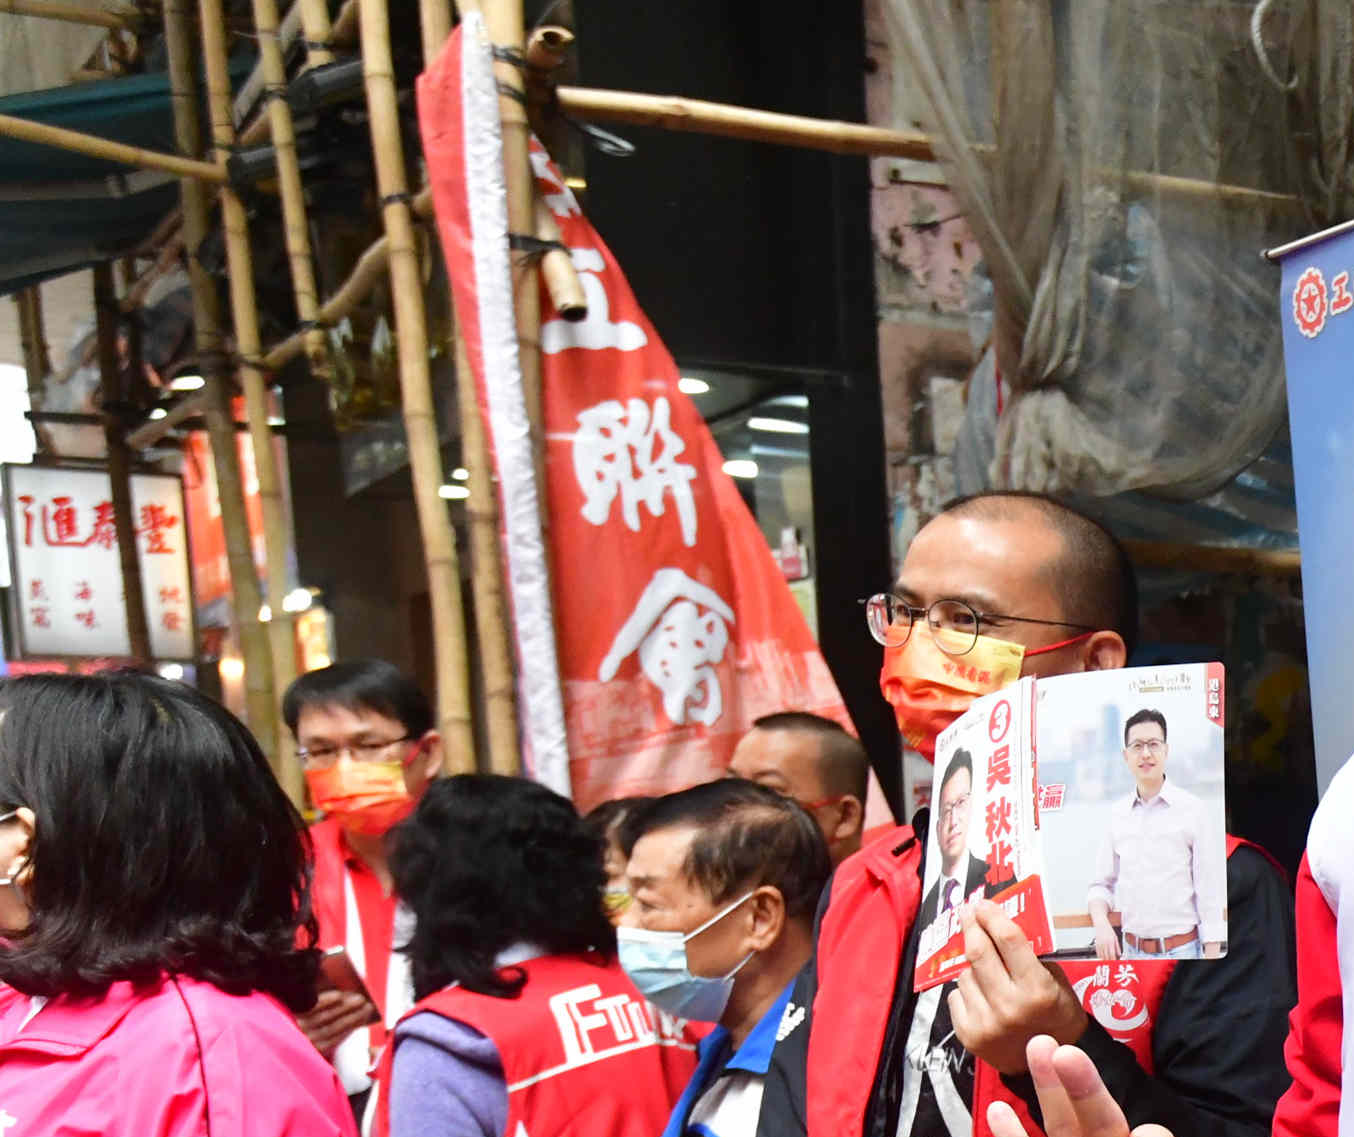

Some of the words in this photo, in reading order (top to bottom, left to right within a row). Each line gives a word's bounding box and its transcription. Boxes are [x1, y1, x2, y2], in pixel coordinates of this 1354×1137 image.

[531, 150, 735, 728] 工聯會
[985, 744, 1015, 886] 吳秋北
